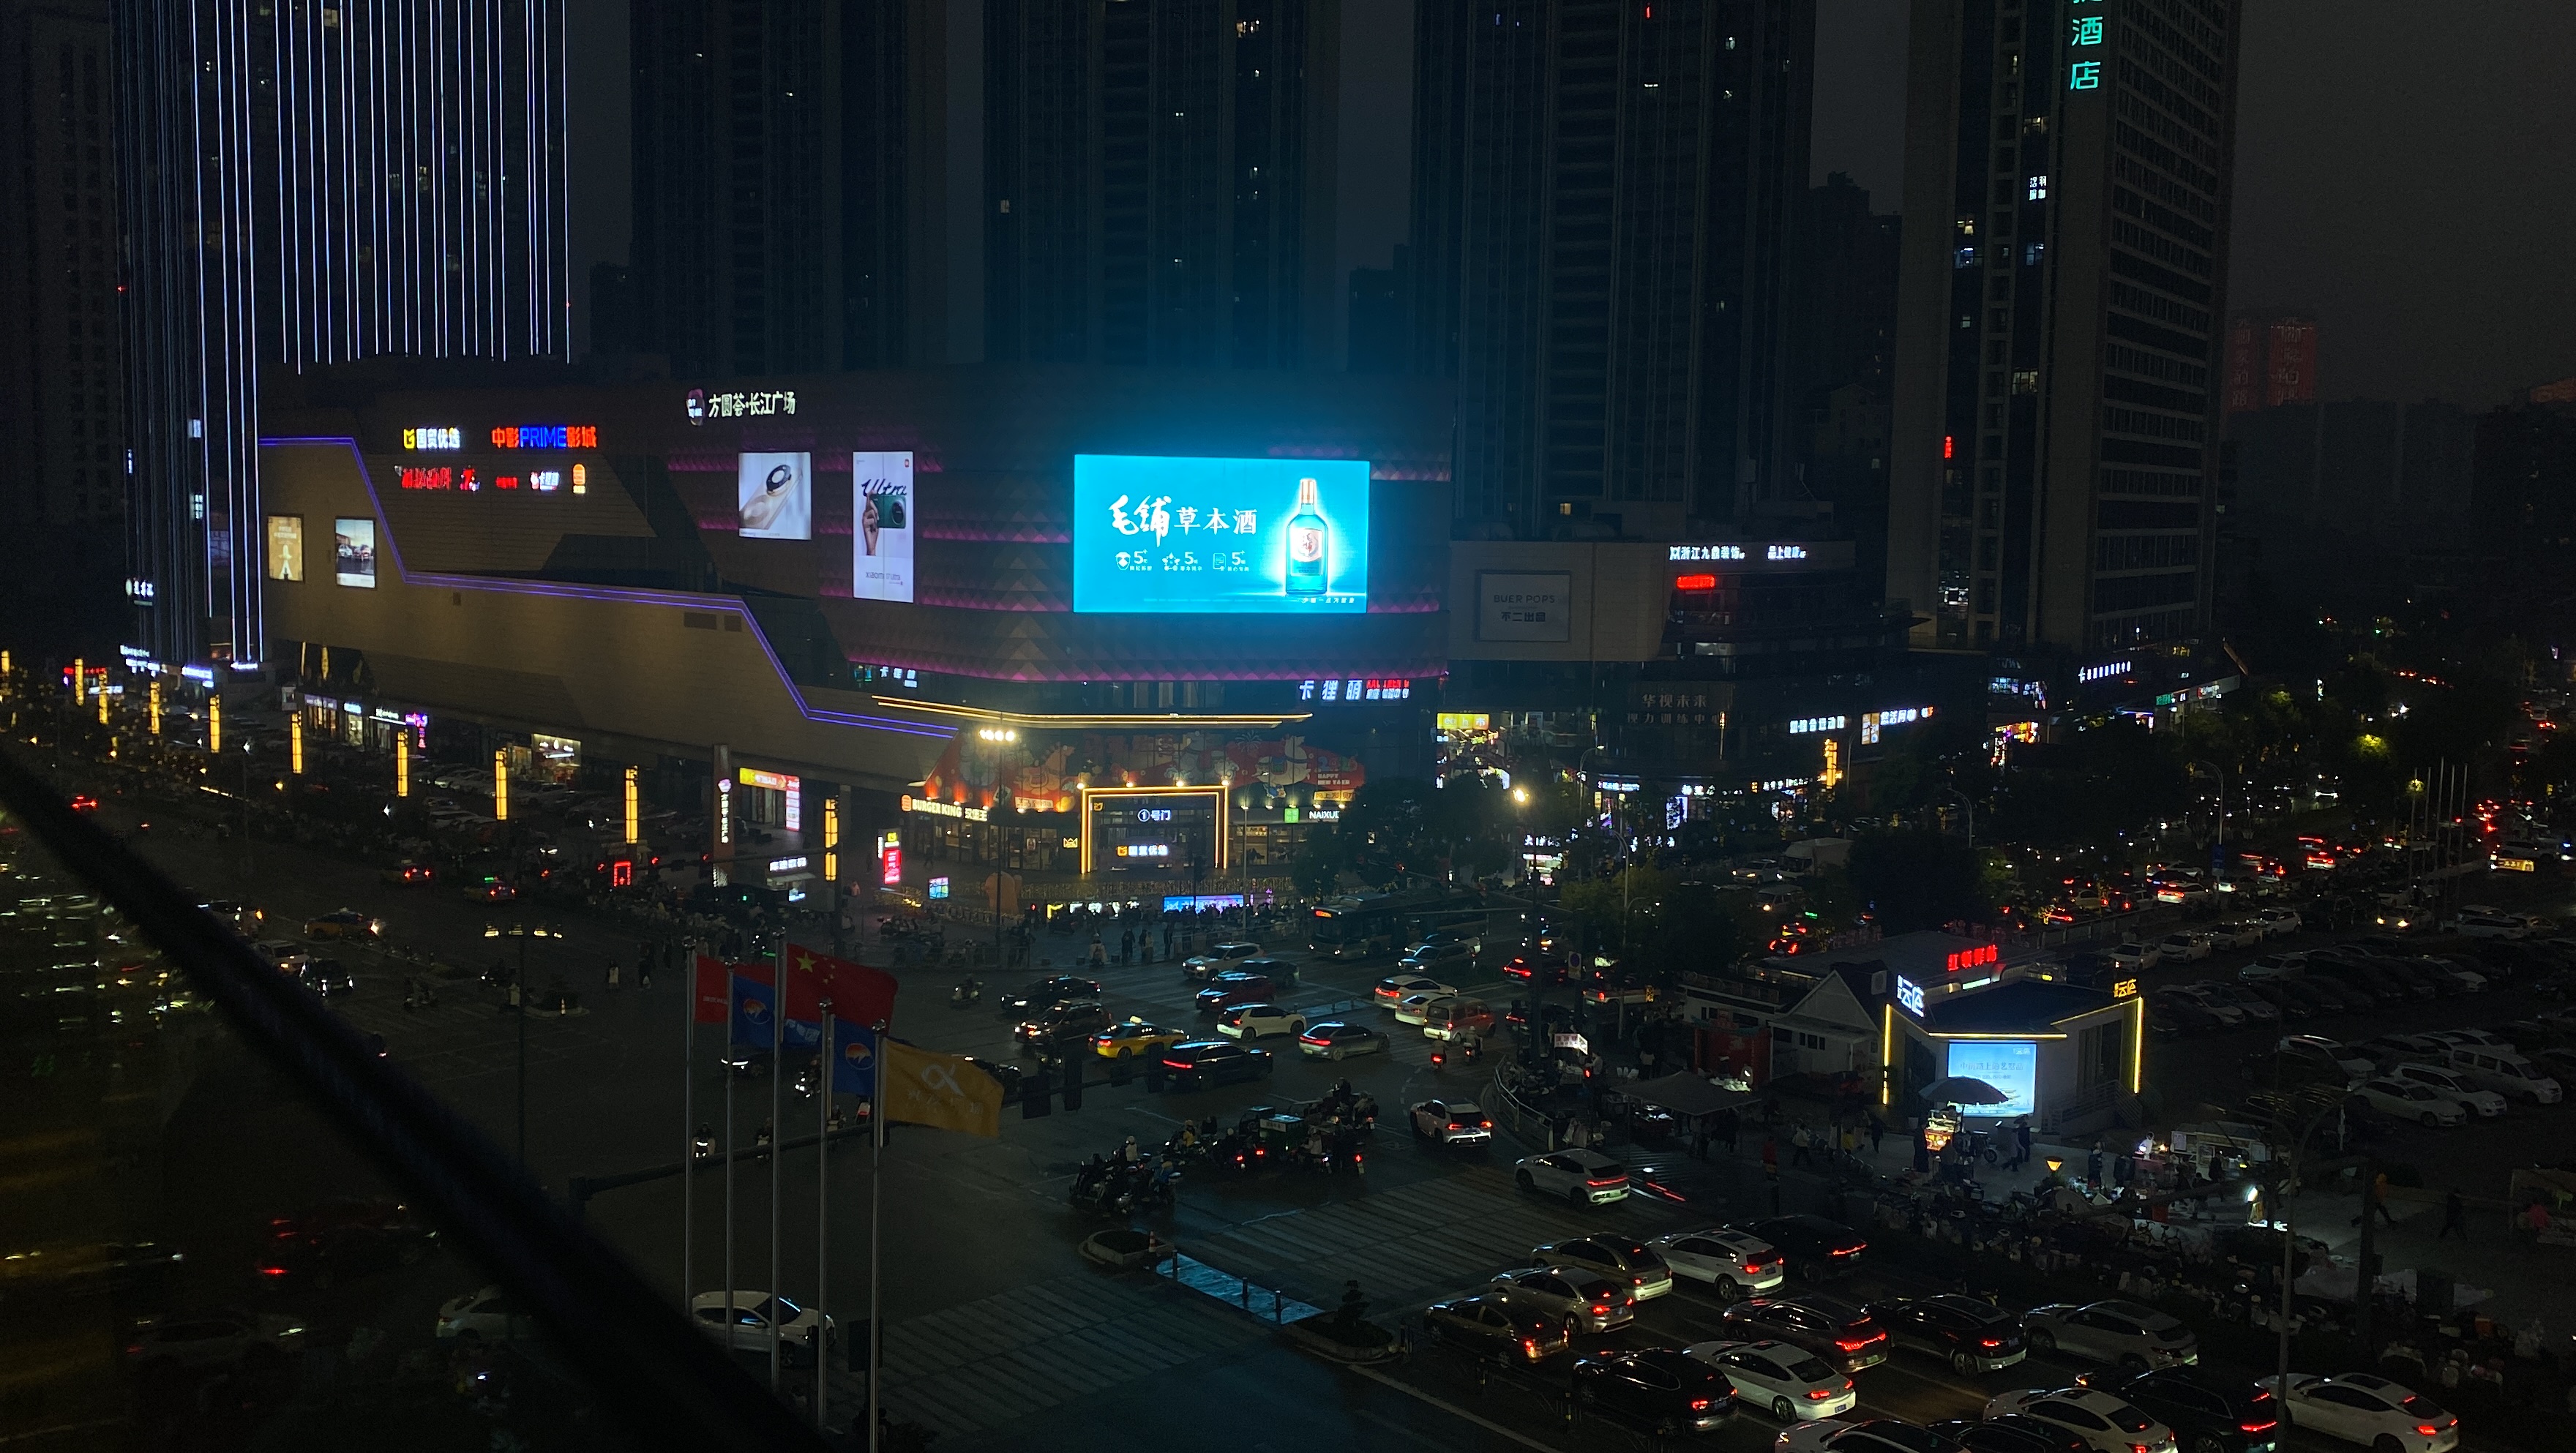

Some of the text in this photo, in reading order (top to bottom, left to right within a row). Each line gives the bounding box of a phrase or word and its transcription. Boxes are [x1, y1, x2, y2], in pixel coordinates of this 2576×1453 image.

[2070, 0, 2103, 90] 酒店
[1494, 594, 1555, 604] BUER POPS
[1641, 694, 1708, 708] 华视未来
[912, 798, 988, 822] BURGER KING 汉堡王
